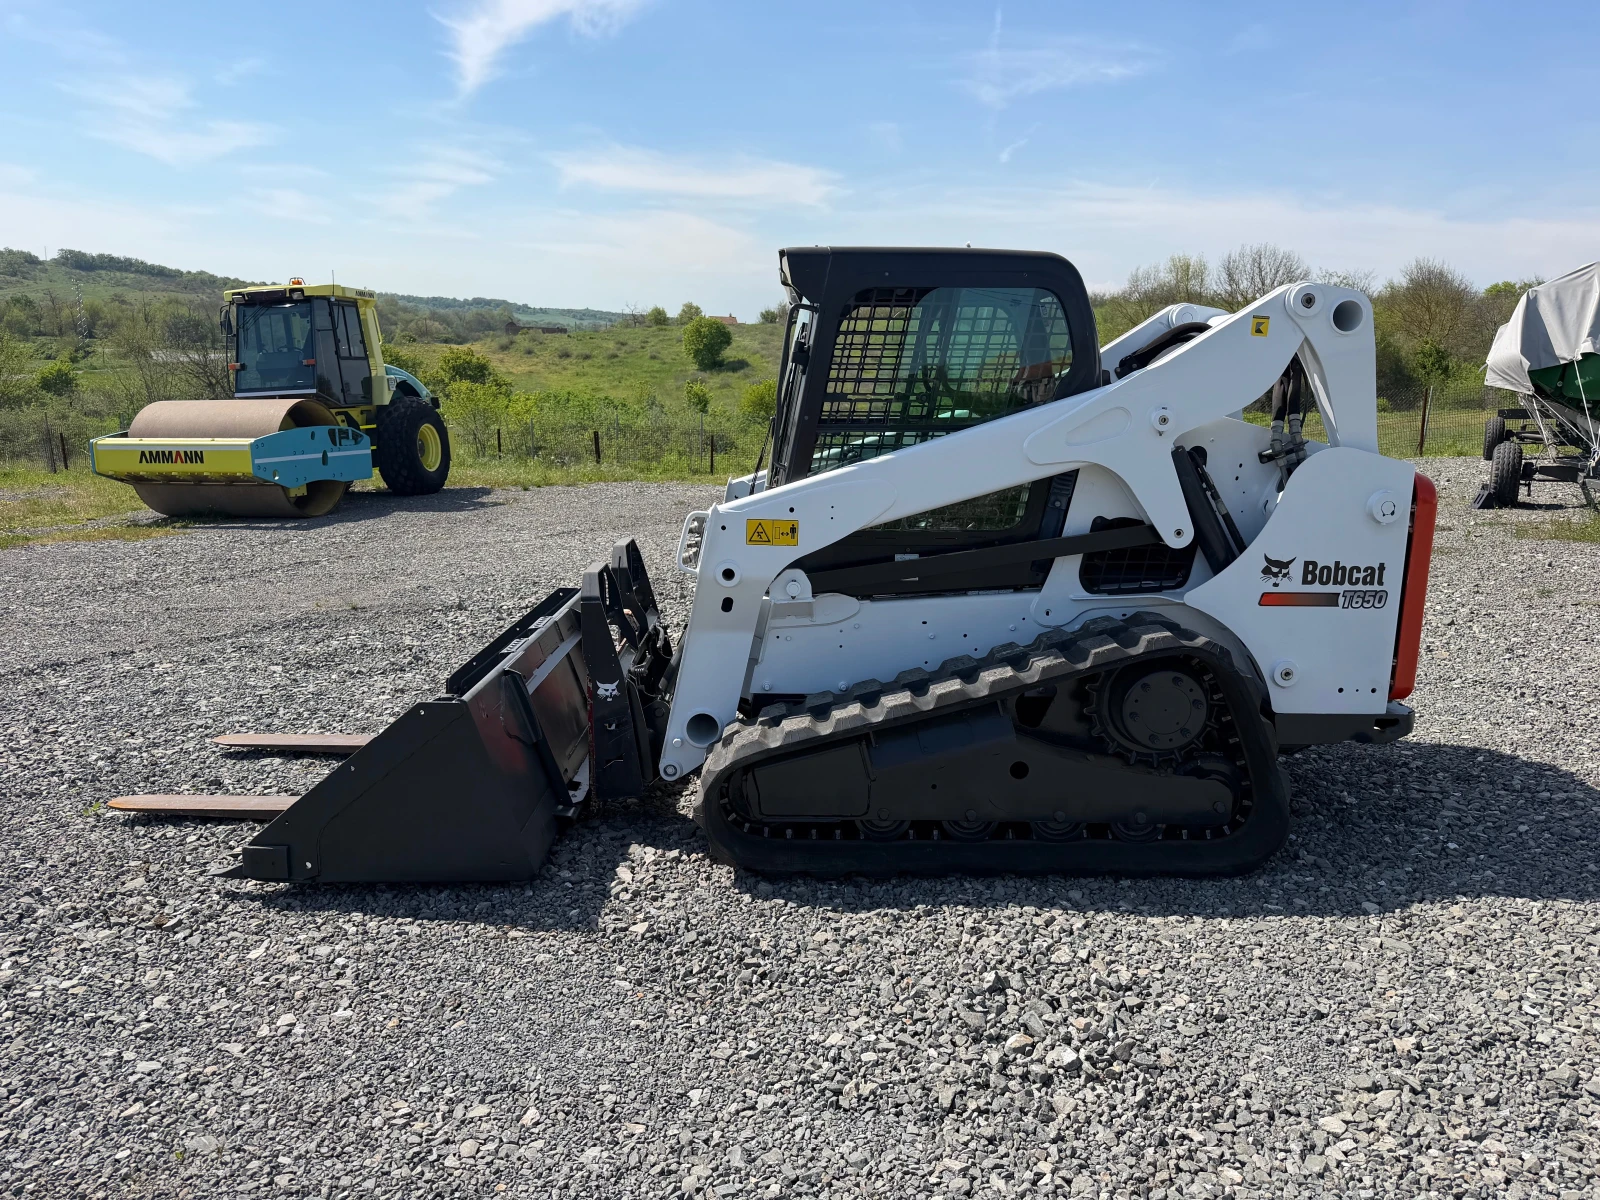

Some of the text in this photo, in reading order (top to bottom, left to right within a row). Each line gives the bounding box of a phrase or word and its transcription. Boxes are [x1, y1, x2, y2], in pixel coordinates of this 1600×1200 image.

[355, 290, 375, 299] AMMANN
[138, 450, 205, 464] AMMANN
[1301, 560, 1386, 586] Bobcat
[1341, 590, 1388, 609] T650
